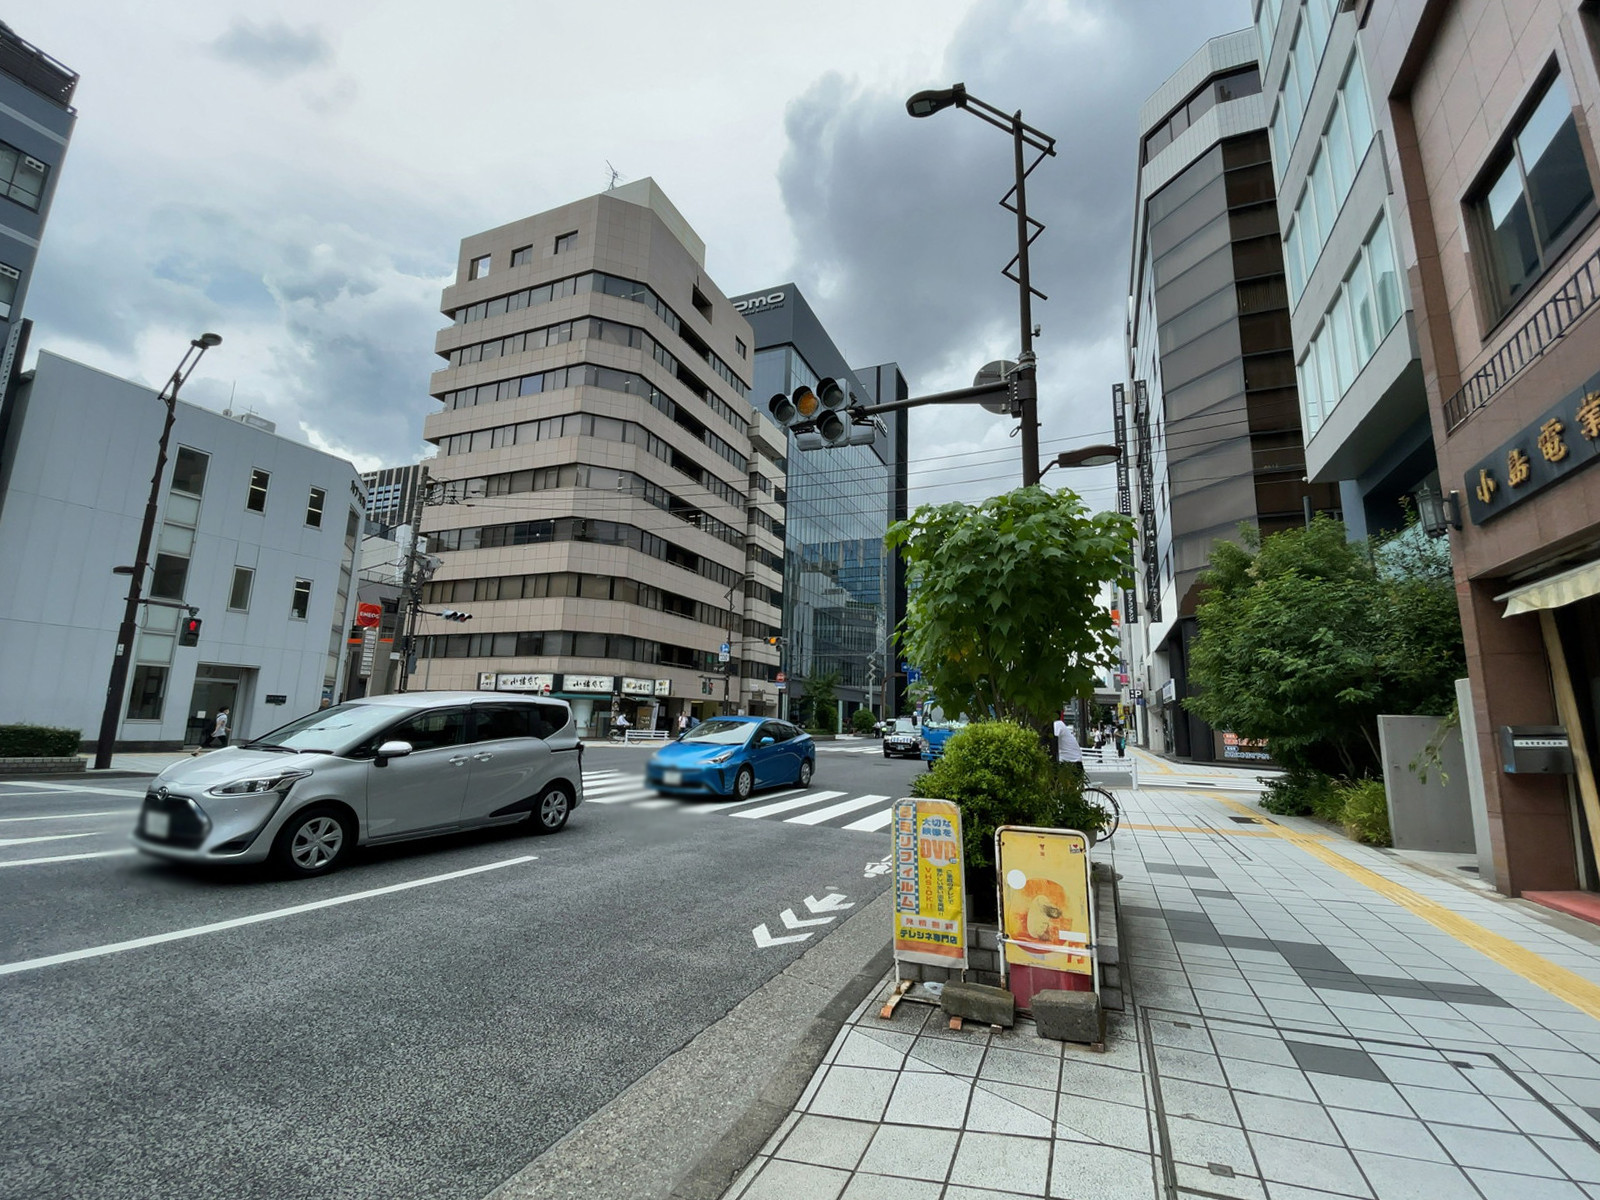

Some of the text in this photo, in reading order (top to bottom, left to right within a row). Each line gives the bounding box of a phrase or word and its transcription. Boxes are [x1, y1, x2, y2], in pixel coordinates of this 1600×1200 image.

[360, 611, 380, 619] ENEOS
[1135, 690, 1142, 698] P
[922, 818, 952, 828] 大切な
[922, 827, 952, 837] 映像を
[920, 838, 957, 861] DVD
[900, 929, 958, 944] テレシネ専門店
